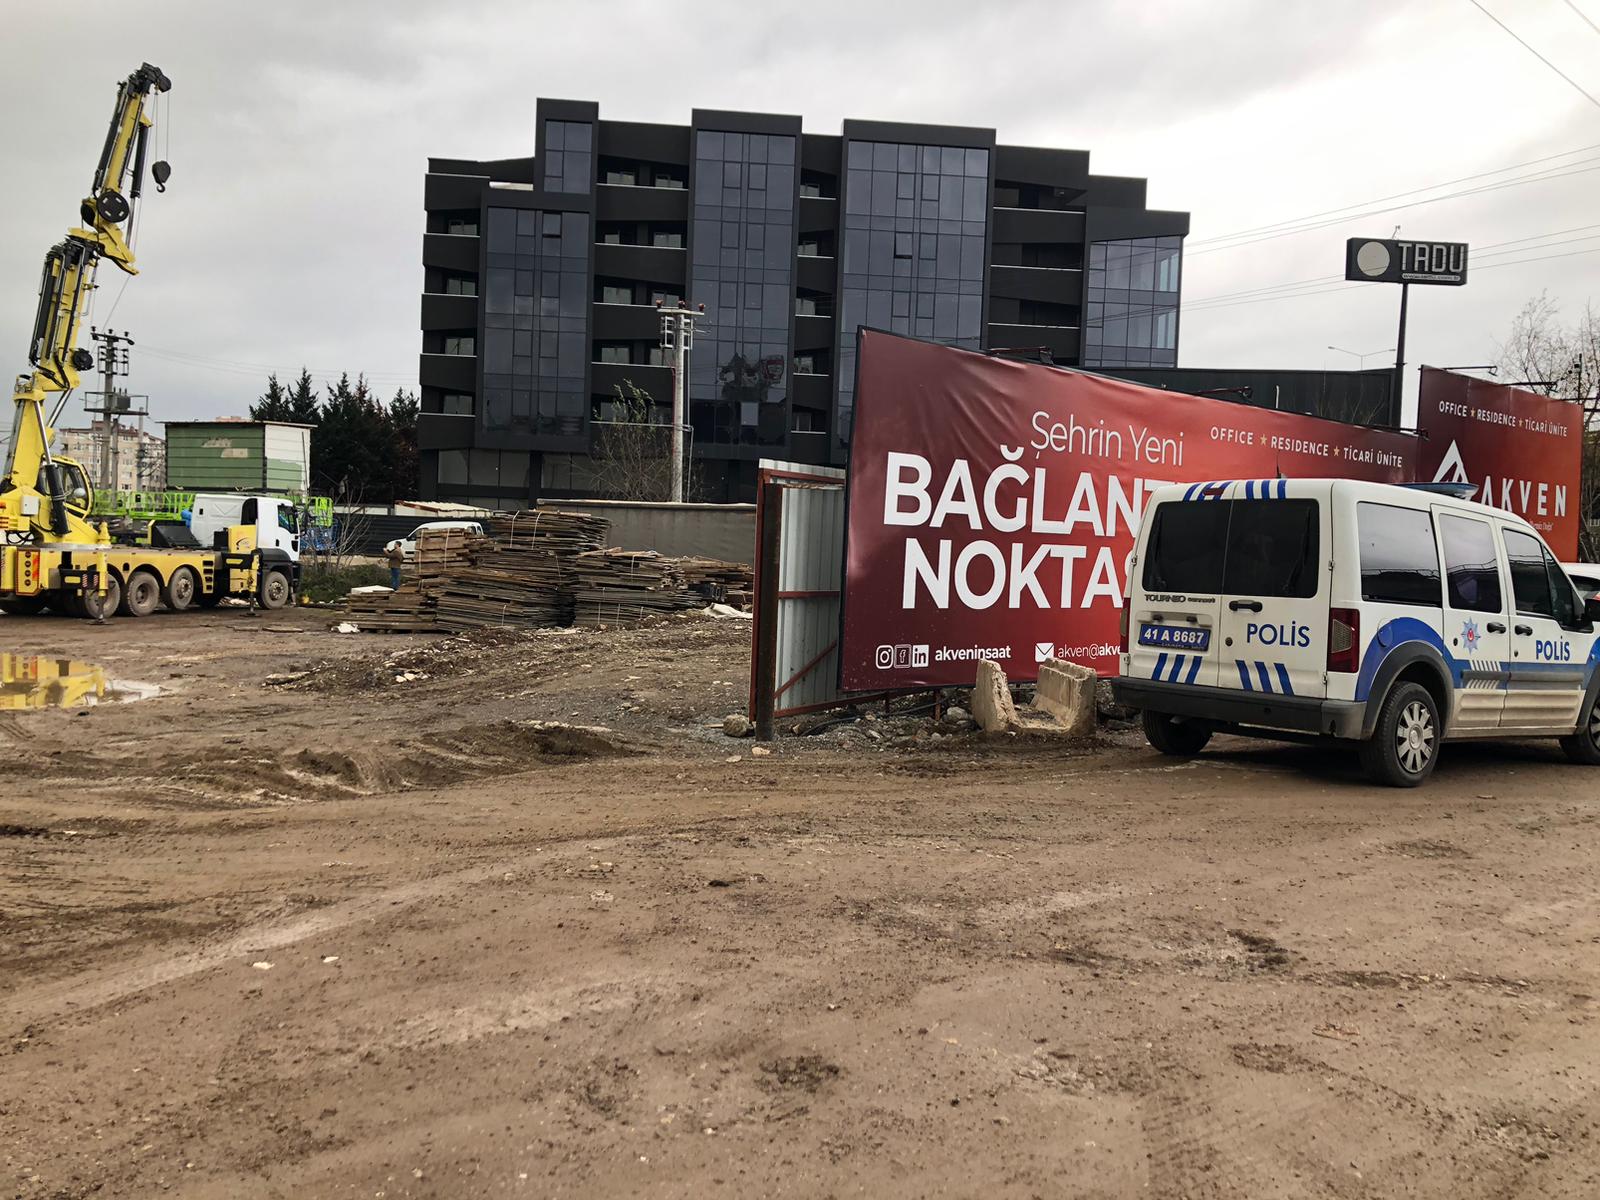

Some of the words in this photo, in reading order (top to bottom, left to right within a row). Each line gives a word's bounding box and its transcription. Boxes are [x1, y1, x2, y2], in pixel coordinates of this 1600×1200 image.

[1398, 242, 1465, 273] TADU
[1438, 400, 1468, 417] OFFICE
[1476, 408, 1517, 427] RESIDENCE
[1525, 417, 1548, 433] TİCARİ
[1548, 421, 1568, 437] ÜNİTE
[1030, 410, 1122, 459] Şehrin
[1128, 424, 1184, 467] Yeni
[1210, 426, 1254, 445] OFFICE
[1270, 436, 1329, 457] RESIDENCE
[1343, 445, 1374, 464] TİCARİ
[1376, 451, 1403, 468] ÜNİTE
[884, 444, 1176, 538] BAĞLAN
[1480, 475, 1567, 517] AKVEN
[902, 537, 1134, 610] NOKTA
[1144, 593, 1187, 603] TOURNEO
[1144, 628, 1158, 640] 41
[1160, 629, 1170, 641] A
[1173, 630, 1204, 644] 8687
[1246, 620, 1311, 648] POLİS
[1535, 634, 1571, 661] POLİS
[934, 644, 1012, 662] akveninsaat
